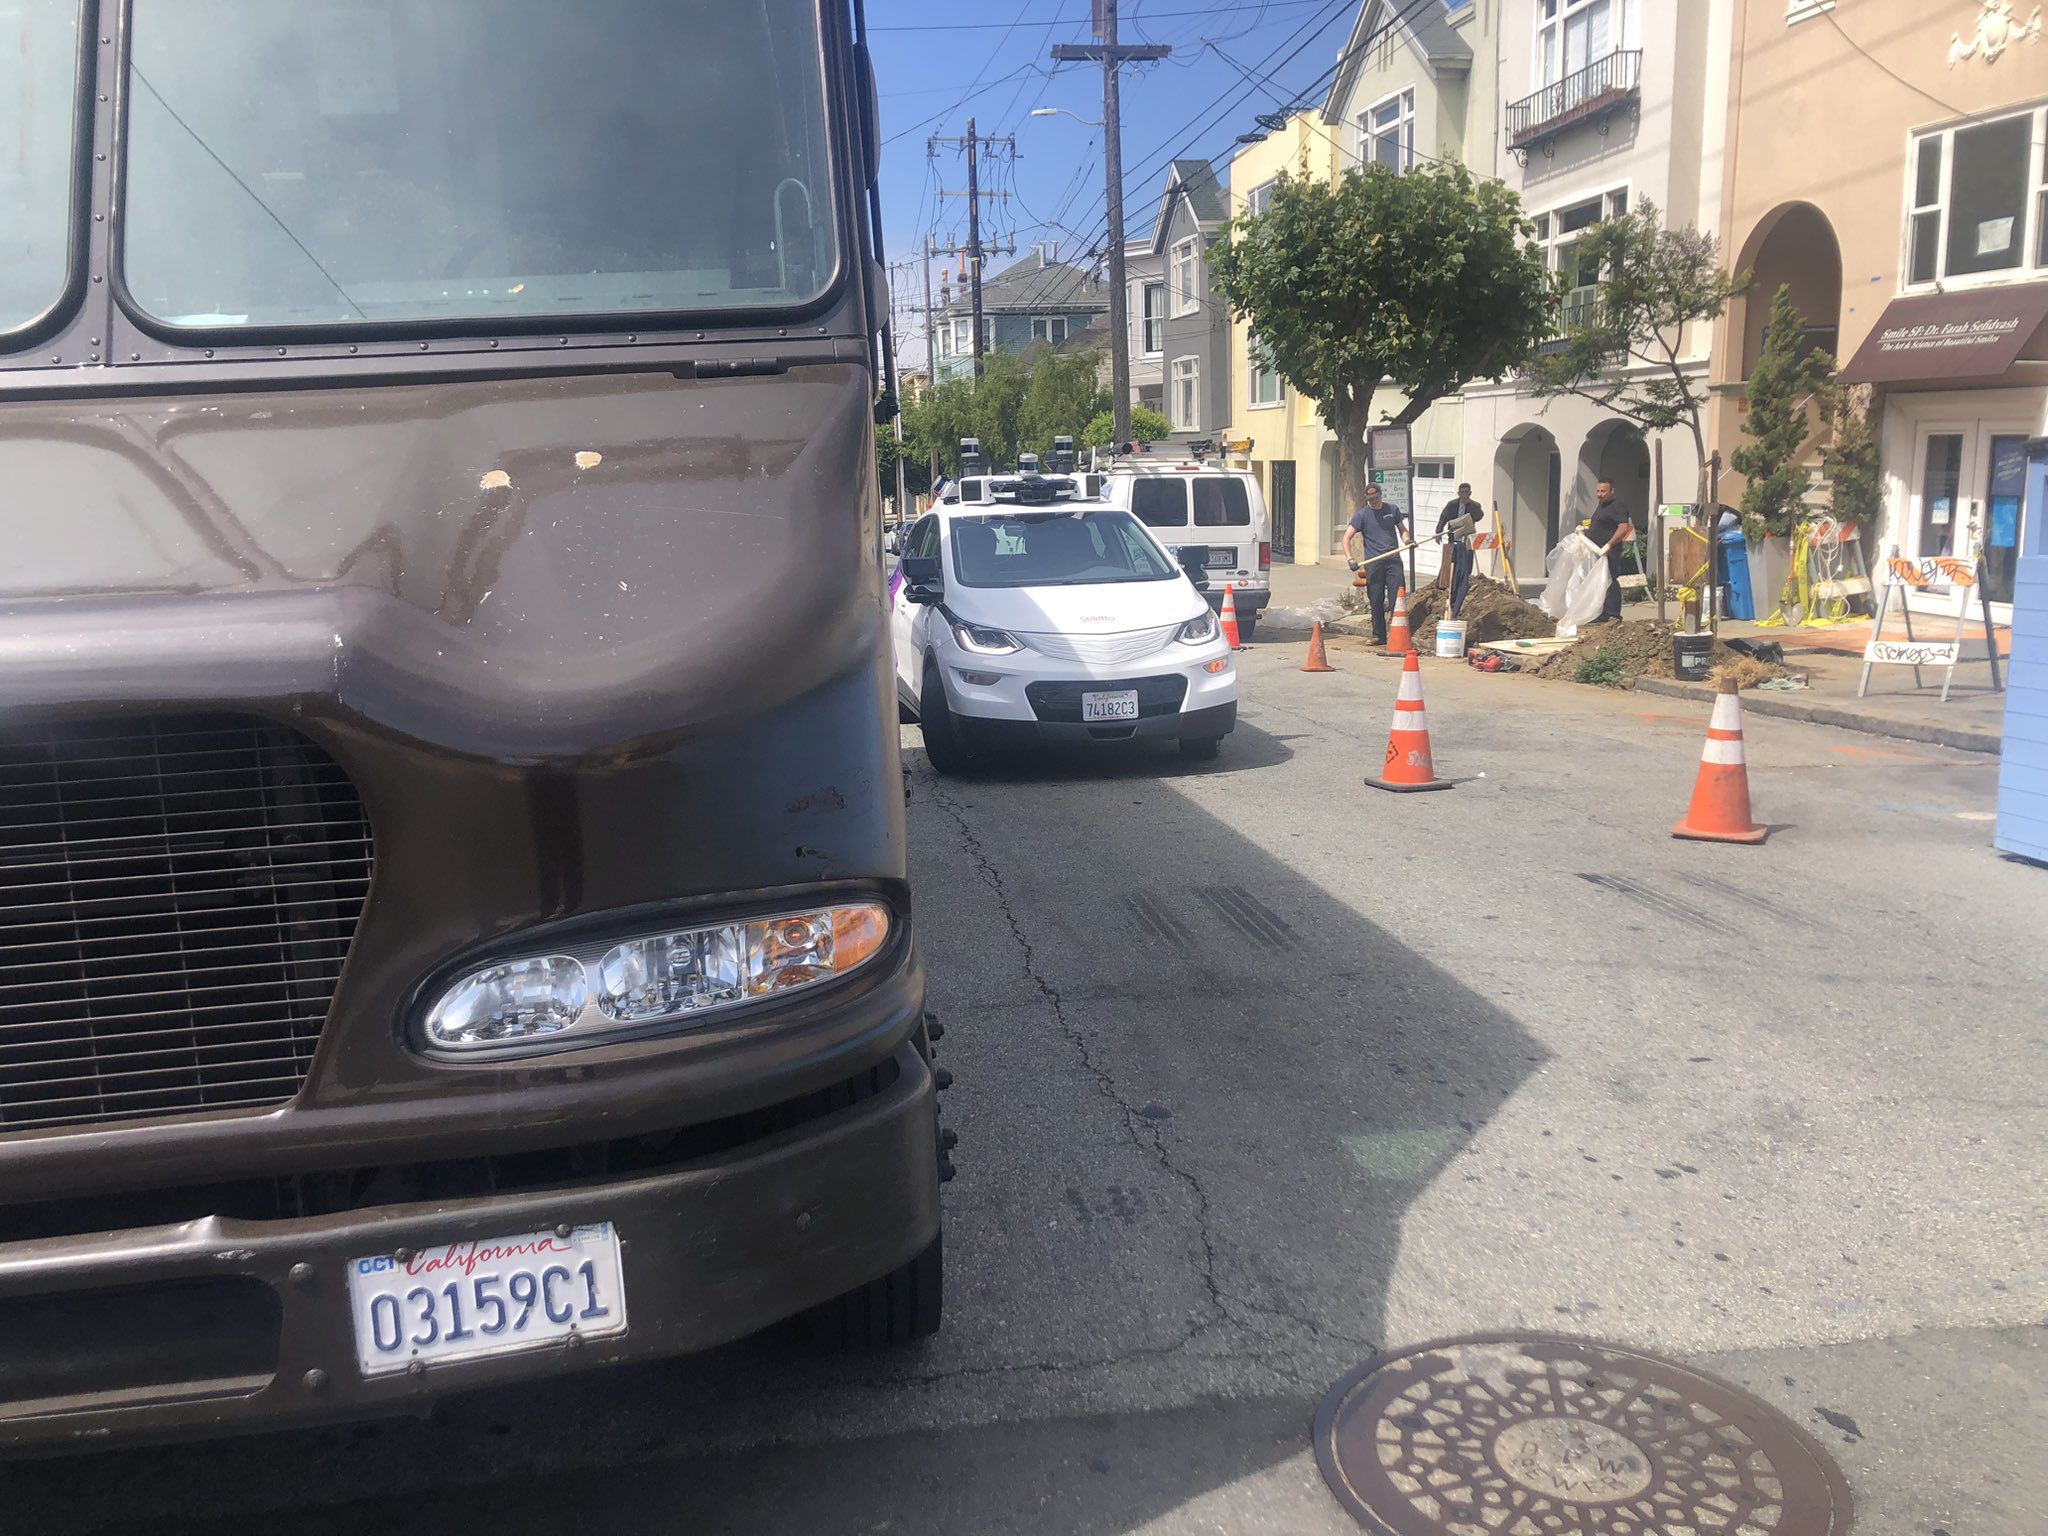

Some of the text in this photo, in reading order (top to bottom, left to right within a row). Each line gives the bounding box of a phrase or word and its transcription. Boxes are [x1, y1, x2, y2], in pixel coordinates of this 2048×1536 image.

[1881, 327, 1908, 340] Smile
[1924, 325, 1939, 336] Dr.
[1940, 322, 1970, 334] Farah
[1969, 317, 2020, 332] Sefidvash
[1880, 342, 1895, 351] The
[1893, 341, 1905, 350] Art
[1911, 339, 1936, 349] Science
[1935, 338, 1945, 347] of
[1944, 336, 1976, 347] Beautiful
[1975, 334, 2001, 344] Smiles
[1375, 472, 1381, 483] 2
[1086, 701, 1135, 717] 74182C3
[405, 1232, 572, 1276] California
[371, 1260, 609, 1351] 03159C1
